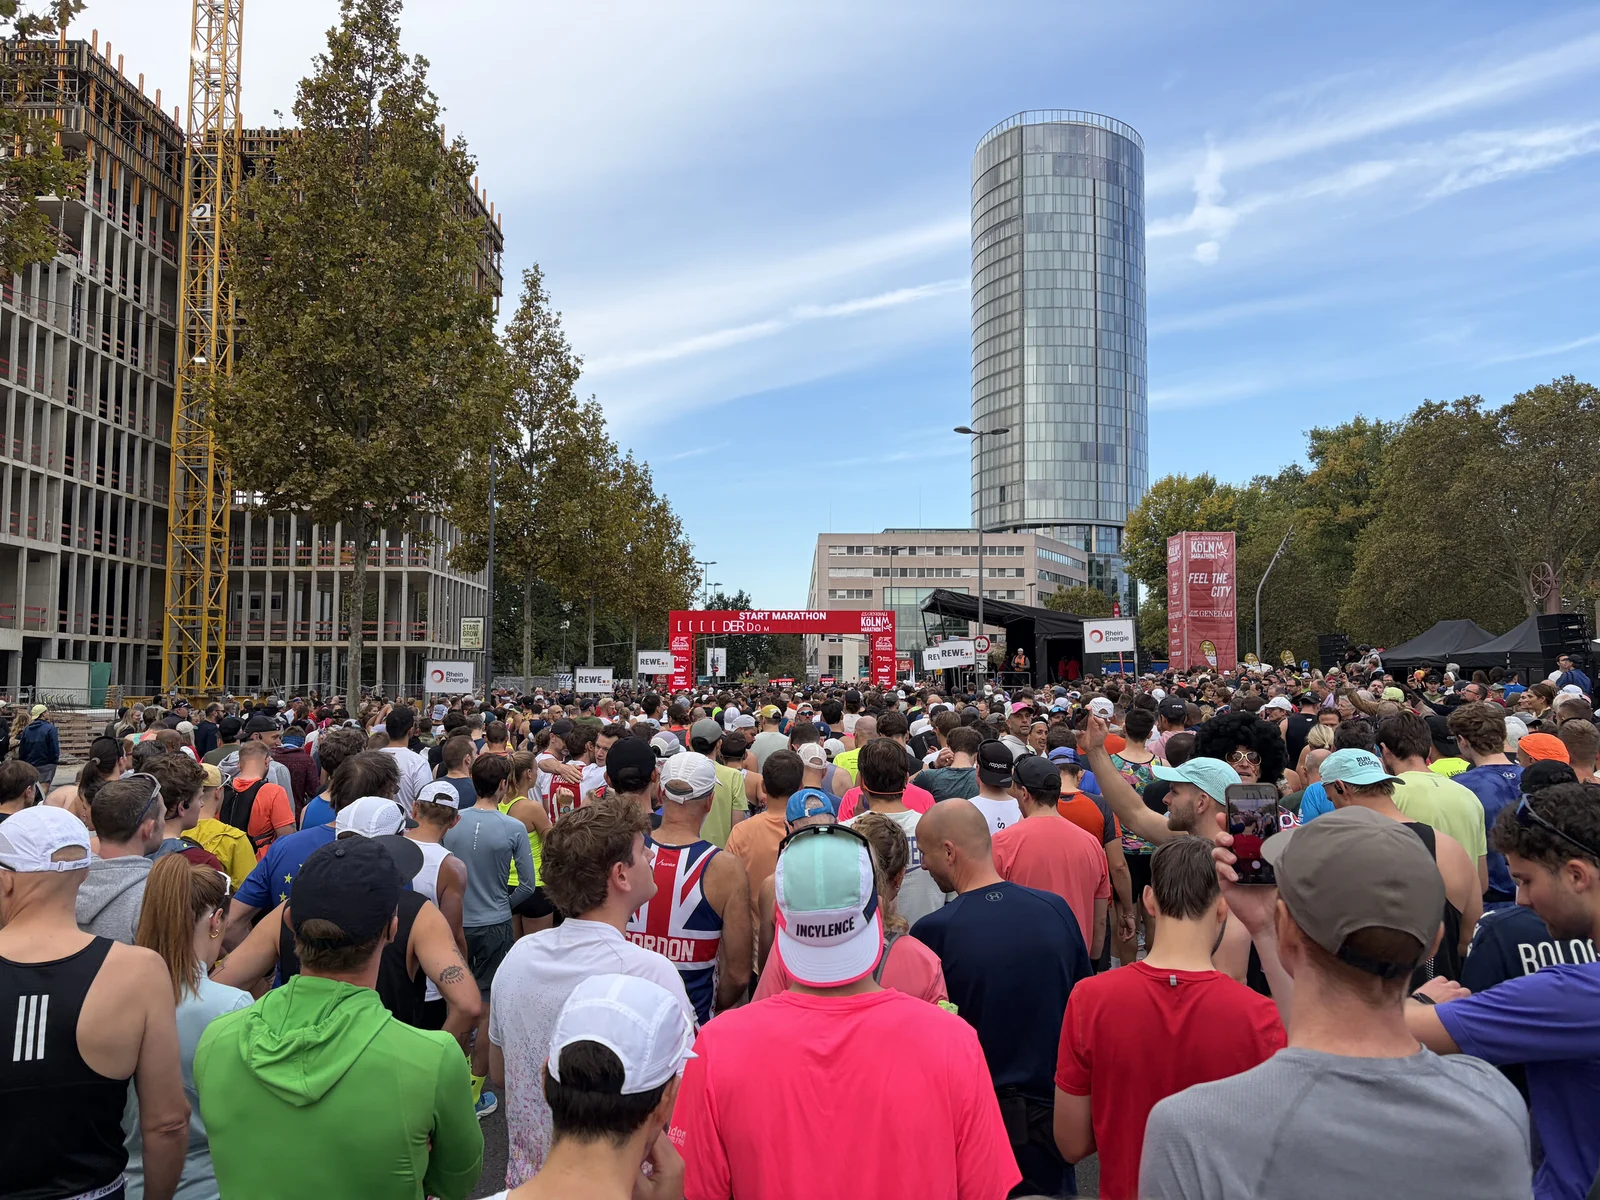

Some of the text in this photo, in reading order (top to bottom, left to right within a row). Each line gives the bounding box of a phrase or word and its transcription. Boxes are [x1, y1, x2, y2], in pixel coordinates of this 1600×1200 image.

[196, 204, 207, 220] 2
[1191, 541, 1215, 553] KÖLN
[1188, 572, 1209, 584] FEEL
[1211, 572, 1229, 584] THE
[1211, 585, 1232, 597] CITY
[739, 611, 827, 620] START MARATHON
[1199, 610, 1233, 618] GENERALI
[722, 620, 745, 632] DER
[861, 616, 881, 627] KÖLN
[941, 649, 965, 657] REWE
[578, 675, 602, 684] REWE
[796, 916, 855, 938] INCYLENCE
